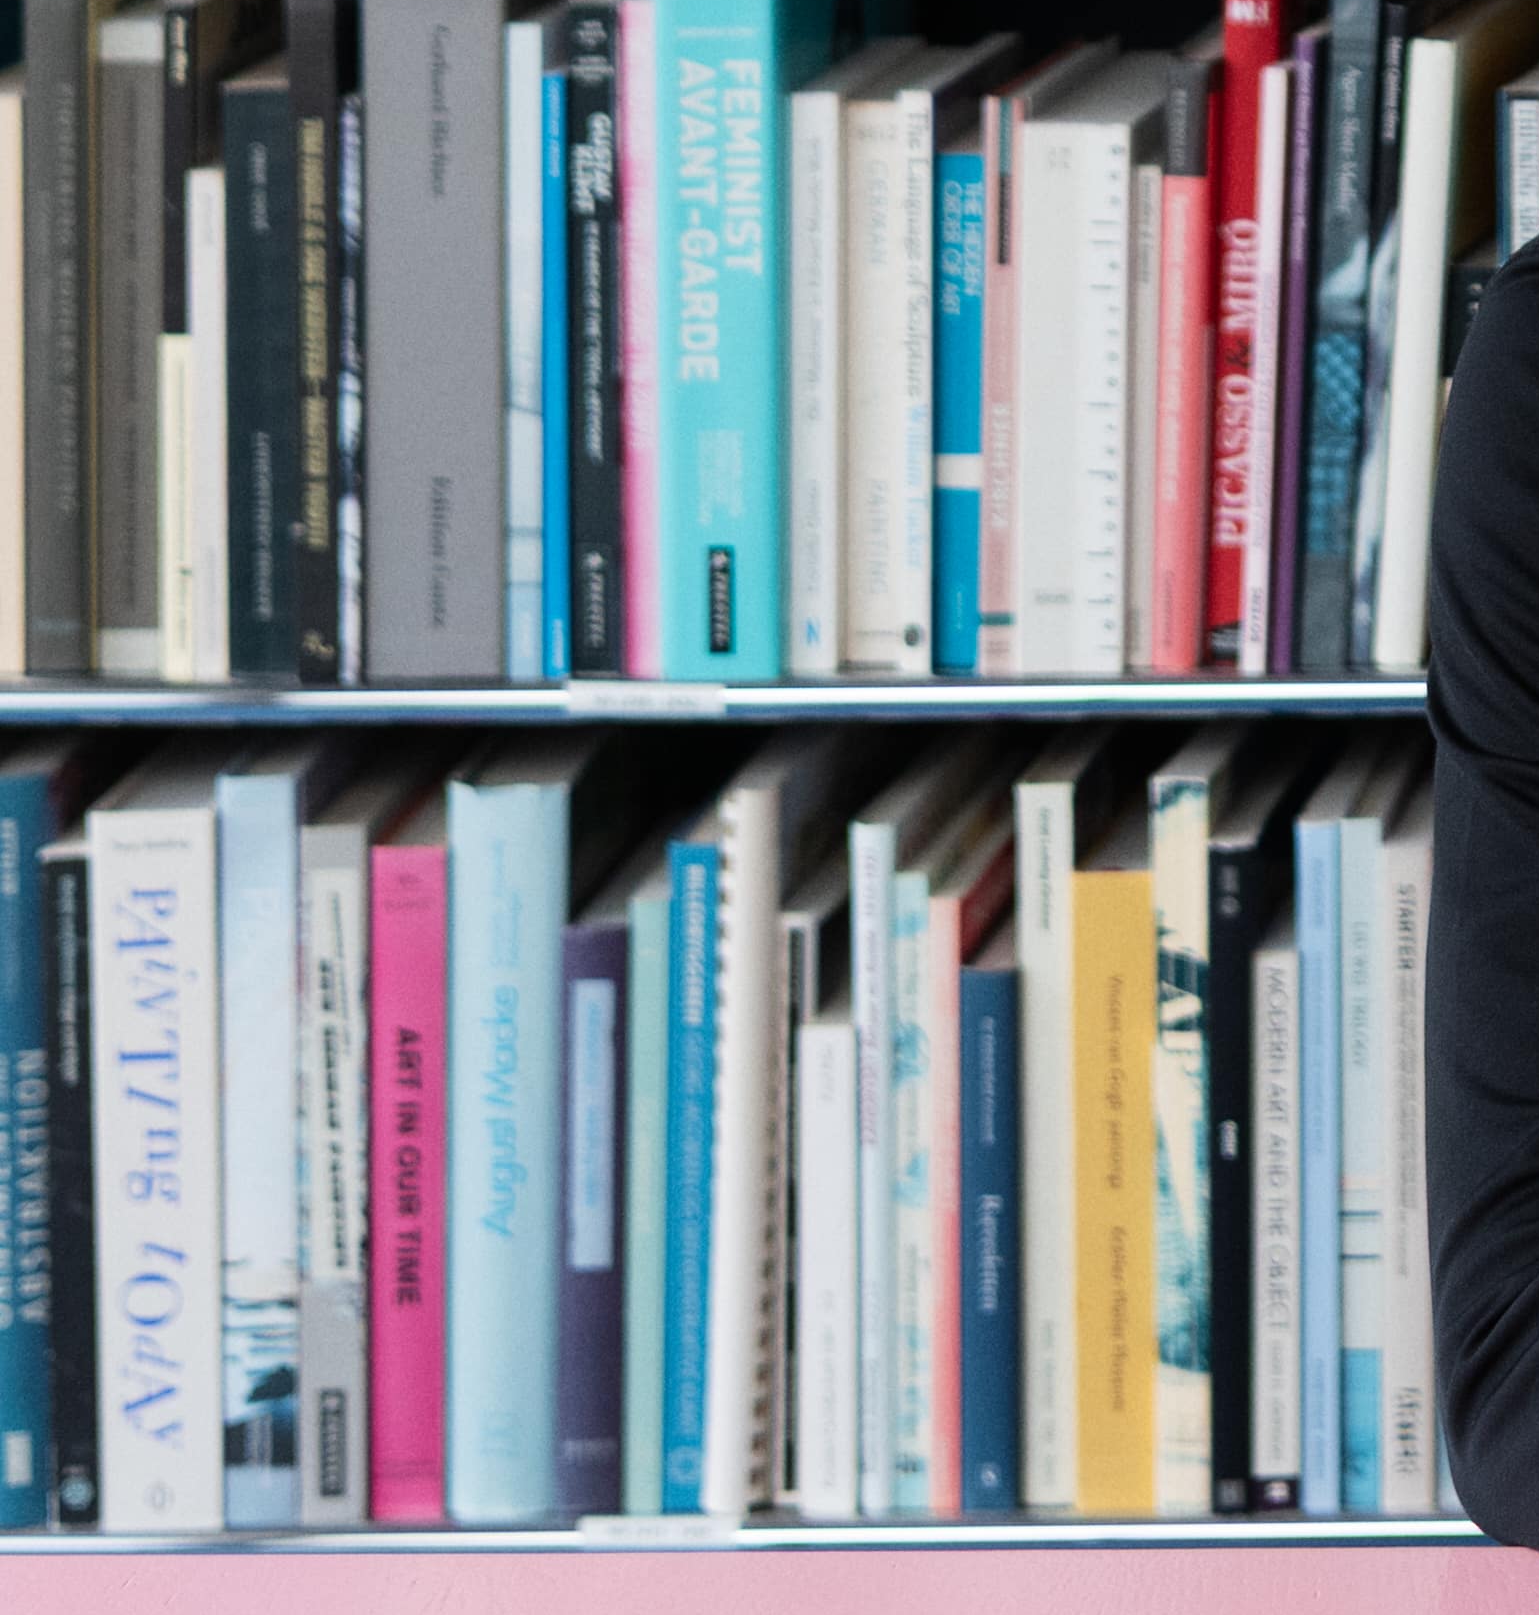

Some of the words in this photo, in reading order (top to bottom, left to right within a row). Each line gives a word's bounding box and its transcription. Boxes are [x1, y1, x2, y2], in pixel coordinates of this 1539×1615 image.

[680, 59, 717, 381] AVANT-GARDE
[724, 59, 761, 275] FEMINIST
[1215, 374, 1256, 547] PICASSO
